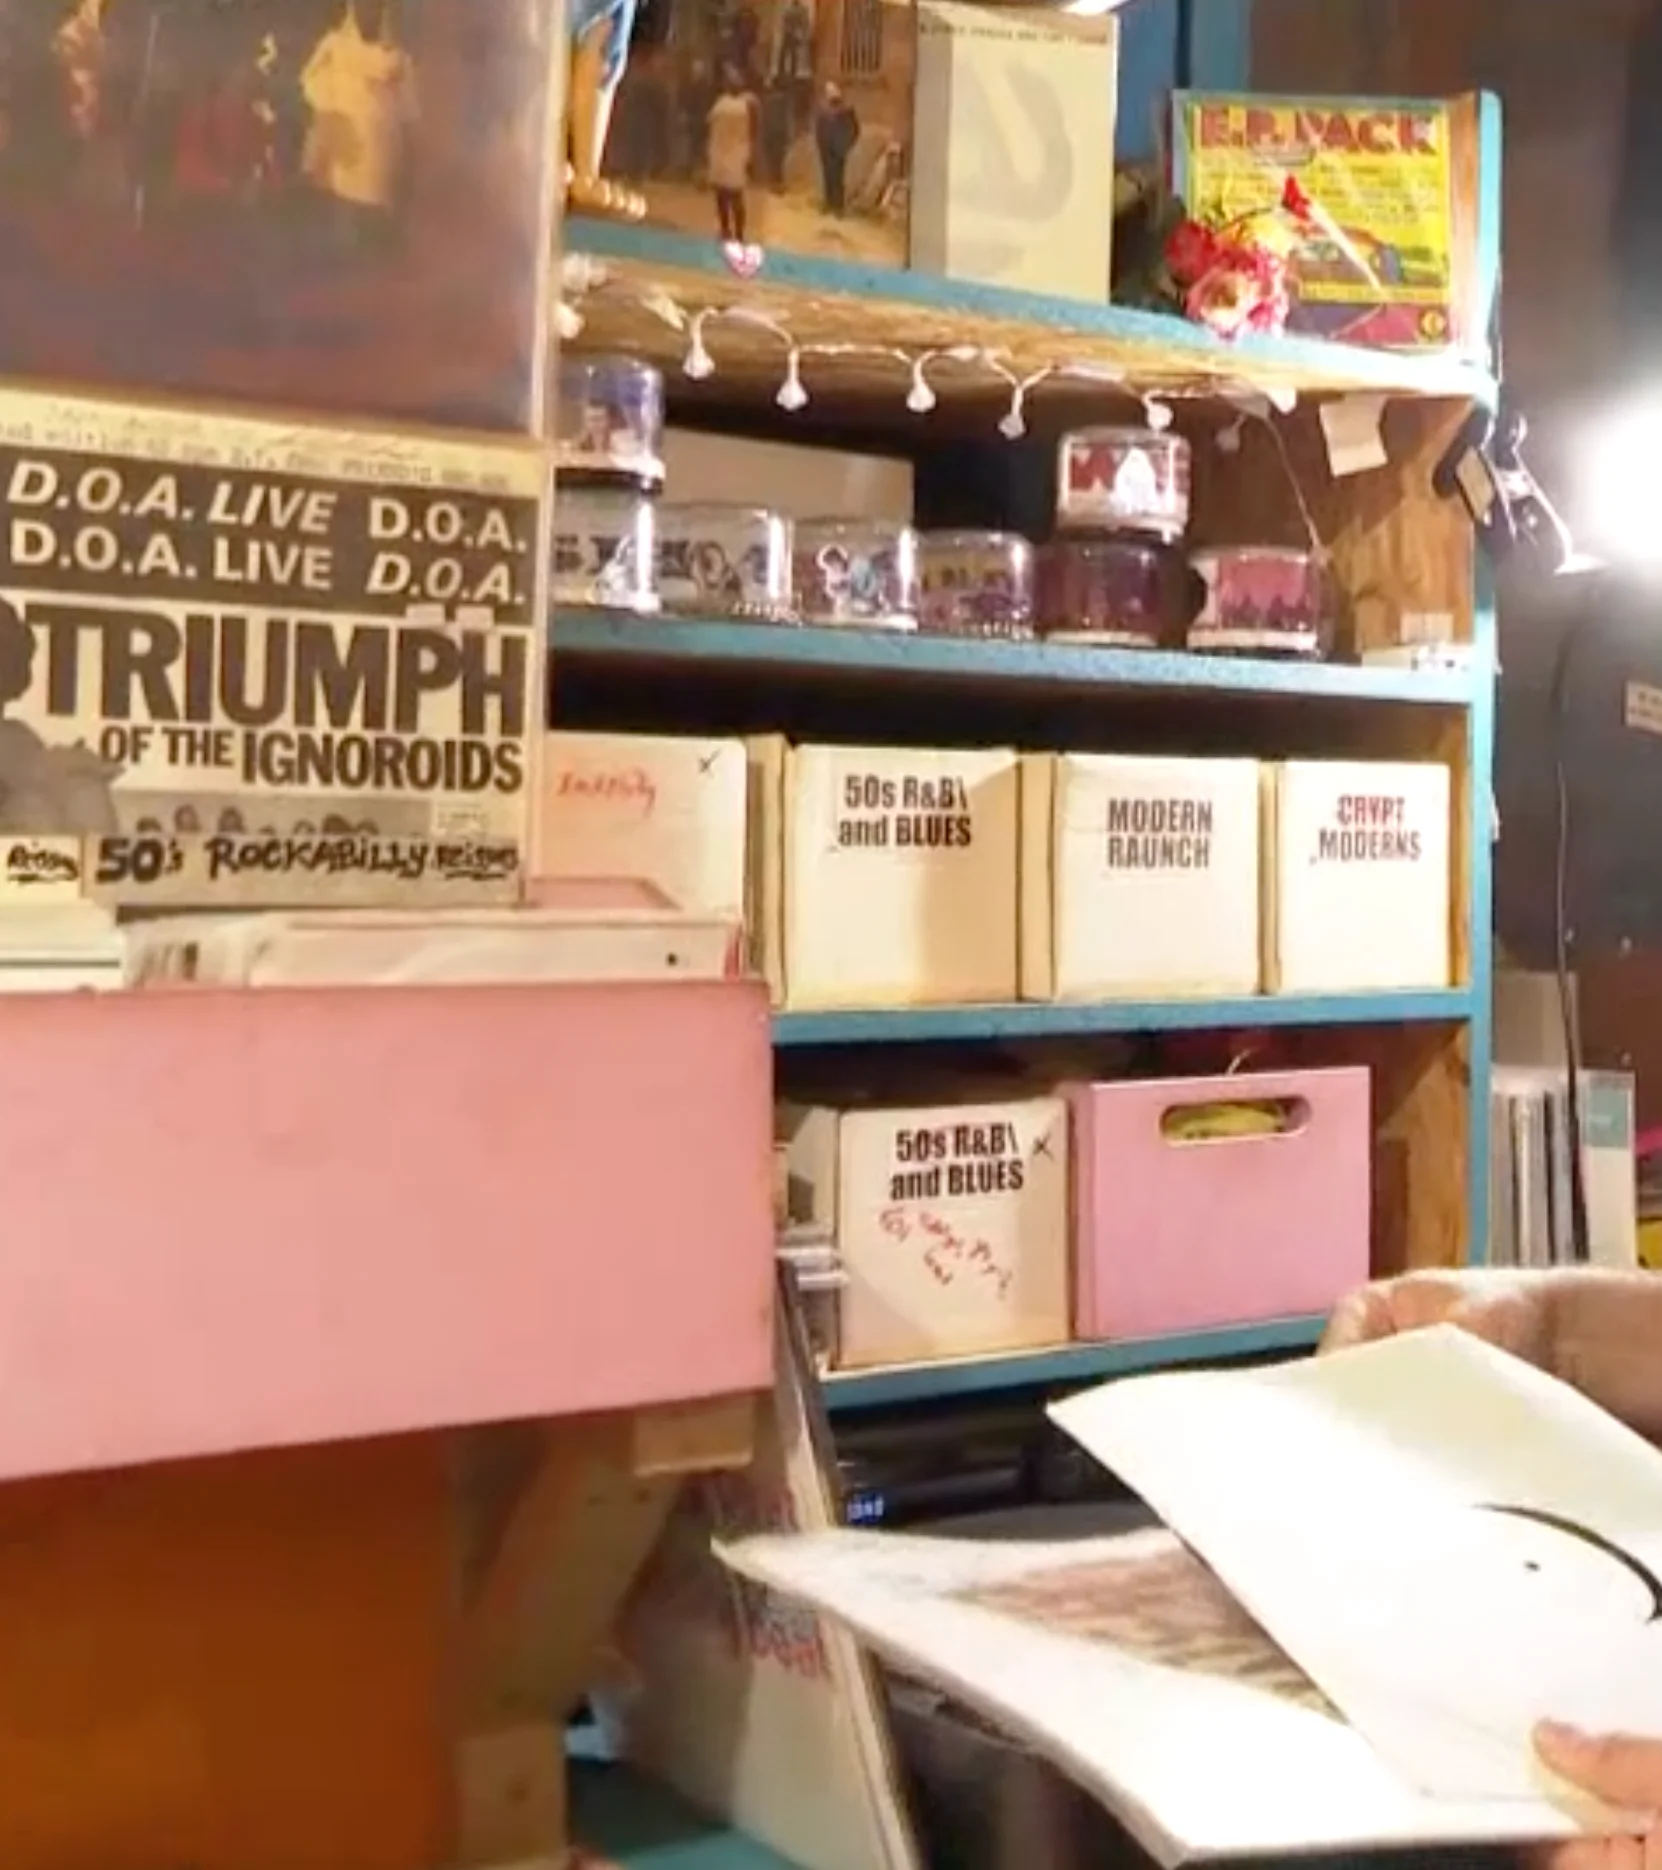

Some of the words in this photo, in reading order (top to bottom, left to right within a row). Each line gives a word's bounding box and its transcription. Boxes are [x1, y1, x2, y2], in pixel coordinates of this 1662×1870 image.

[7, 460, 194, 521] D.O.A.
[207, 480, 338, 534] LIVE
[368, 497, 528, 552] D.O.A.
[9, 518, 197, 579] D.O.A.
[213, 537, 334, 590] LIVE
[365, 552, 526, 604] D.O.A.
[25, 601, 527, 738] TRIUMPH
[101, 724, 154, 765] OF
[161, 725, 234, 768] THE
[242, 731, 524, 794] IGNOROIDS
[844, 774, 897, 809] 50s
[1107, 798, 1212, 833] MODERN
[1337, 794, 1406, 825] CRYPT
[838, 814, 889, 847] and
[895, 813, 972, 847] BLUES
[1318, 827, 1422, 862] MODERNS
[1107, 835, 1210, 869] RAUNCH
[895, 1128, 947, 1162] 50s
[889, 1167, 941, 1201] and
[948, 1159, 1025, 1197] BLUES
